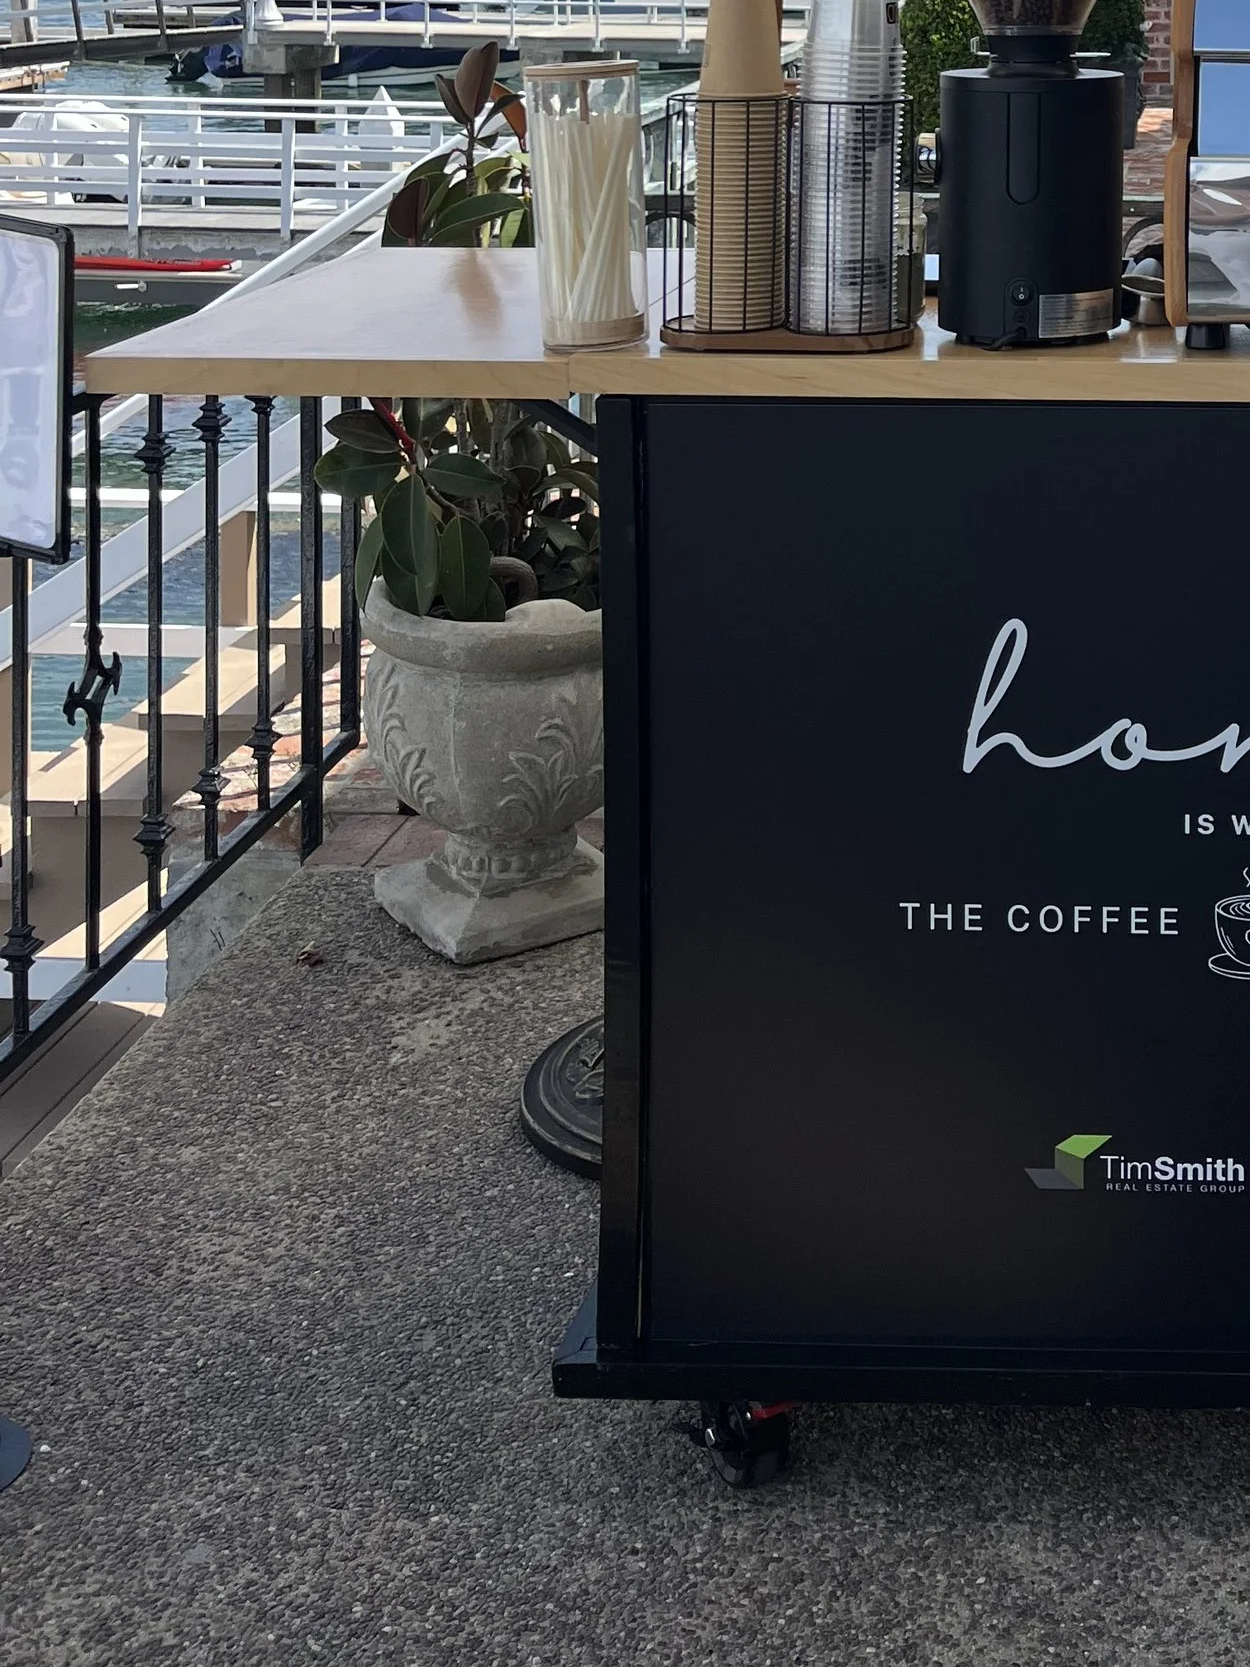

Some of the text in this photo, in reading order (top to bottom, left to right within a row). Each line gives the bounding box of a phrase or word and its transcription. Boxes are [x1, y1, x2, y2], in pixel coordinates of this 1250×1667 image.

[1184, 813, 1215, 835] IS
[899, 902, 983, 931] THE
[1007, 904, 1179, 935] COFFEE
[1099, 1155, 1245, 1182] TimSmith
[1106, 1182, 1245, 1194] REAL ESTATE GROUP
